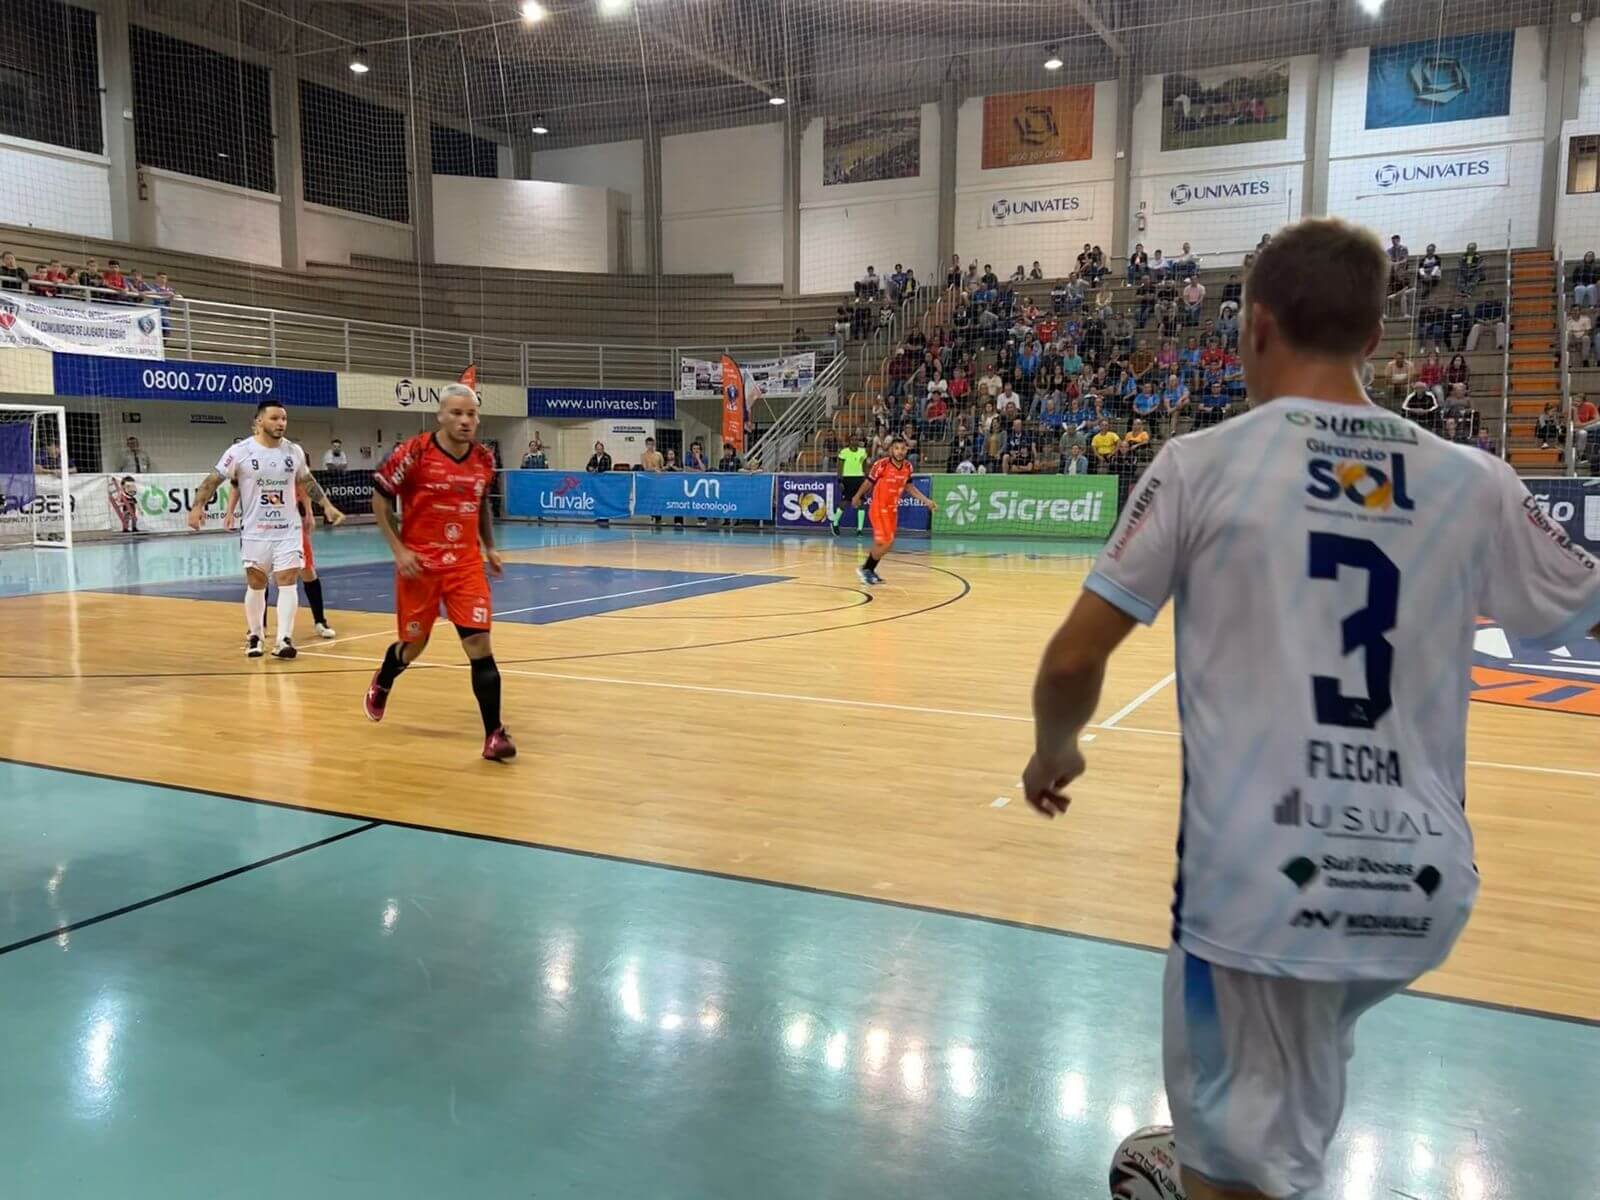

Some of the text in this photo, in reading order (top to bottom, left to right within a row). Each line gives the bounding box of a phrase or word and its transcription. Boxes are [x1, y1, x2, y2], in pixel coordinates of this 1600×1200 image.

[1402, 160, 1489, 181] UNIVATES
[1194, 181, 1269, 200] UNIVATES
[1012, 197, 1079, 214] UNIVATES
[143, 369, 273, 394] 0800.707.0809
[546, 397, 658, 411] www.univates.br
[1306, 438, 1386, 460] Girando
[252, 459, 259, 470] 9
[324, 486, 375, 496] ARDROOM
[783, 481, 824, 491] Girando
[540, 491, 594, 510] Univale
[666, 501, 737, 513] smart tecnologia
[987, 490, 1104, 523] Sicredi
[1308, 530, 1400, 729] 3
[1308, 740, 1402, 787] FLECHA
[1304, 802, 1443, 836] USUAL
